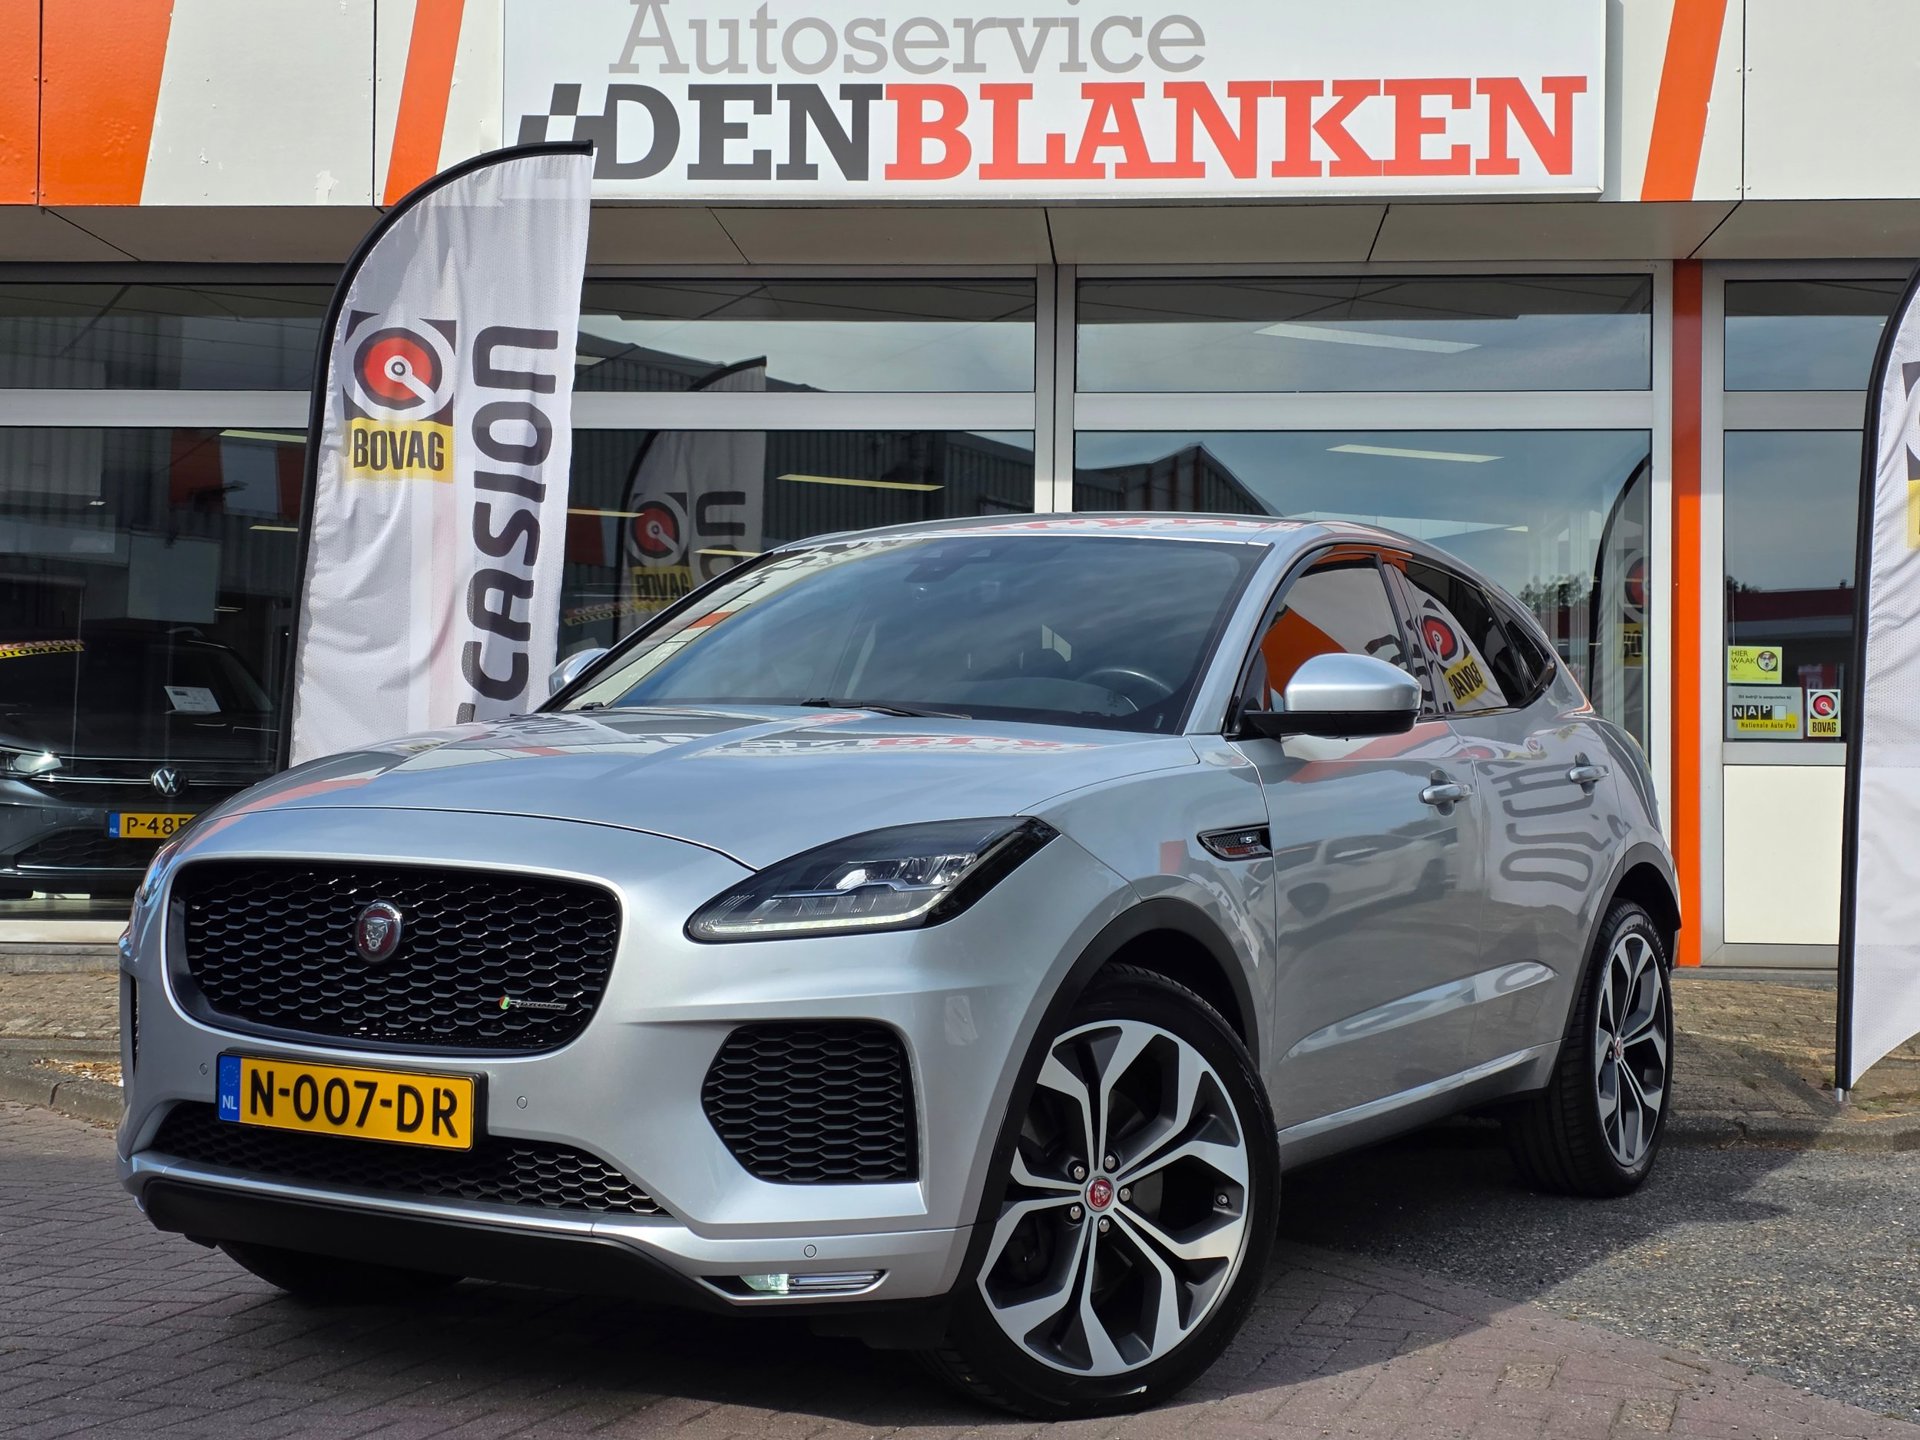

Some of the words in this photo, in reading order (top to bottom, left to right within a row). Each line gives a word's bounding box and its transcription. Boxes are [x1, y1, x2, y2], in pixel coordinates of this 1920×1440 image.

[608, 0, 1205, 74] Autoservice
[352, 427, 445, 472] BOVAG
[1731, 657, 1756, 665] WAAK
[1733, 705, 1772, 718] NAP
[1812, 722, 1837, 733] BOVAG
[222, 1094, 238, 1111] NL
[250, 1068, 458, 1139] N-007-DR
